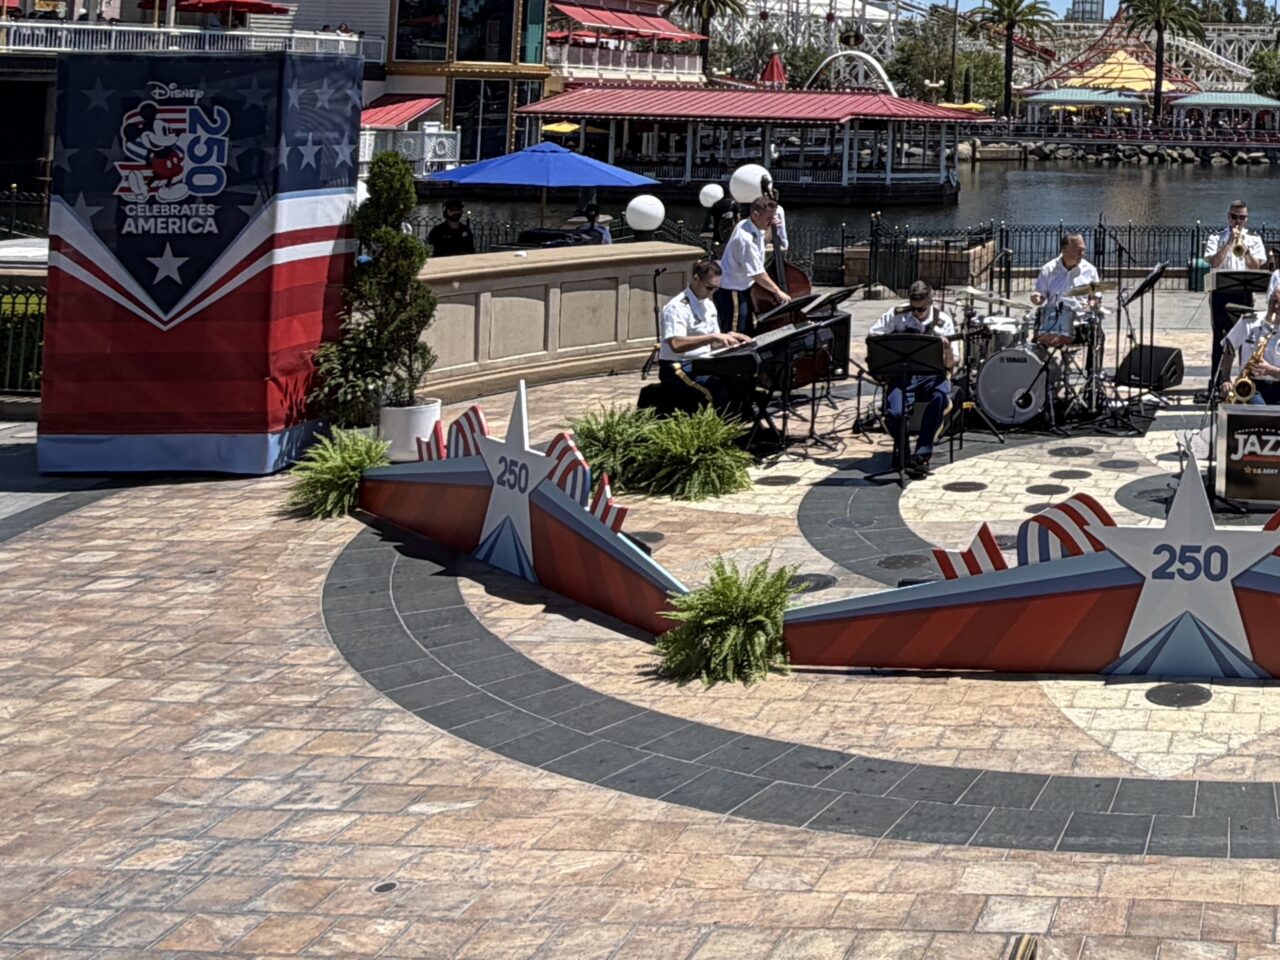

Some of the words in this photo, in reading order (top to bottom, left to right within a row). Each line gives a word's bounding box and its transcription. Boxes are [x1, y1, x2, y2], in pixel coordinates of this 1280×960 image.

[147, 81, 204, 104] Disney
[186, 106, 231, 196] 250
[121, 217, 219, 234] AMERICA
[125, 204, 216, 217] CELEBRATES
[497, 456, 529, 494] 250
[1152, 543, 1228, 582] 250
